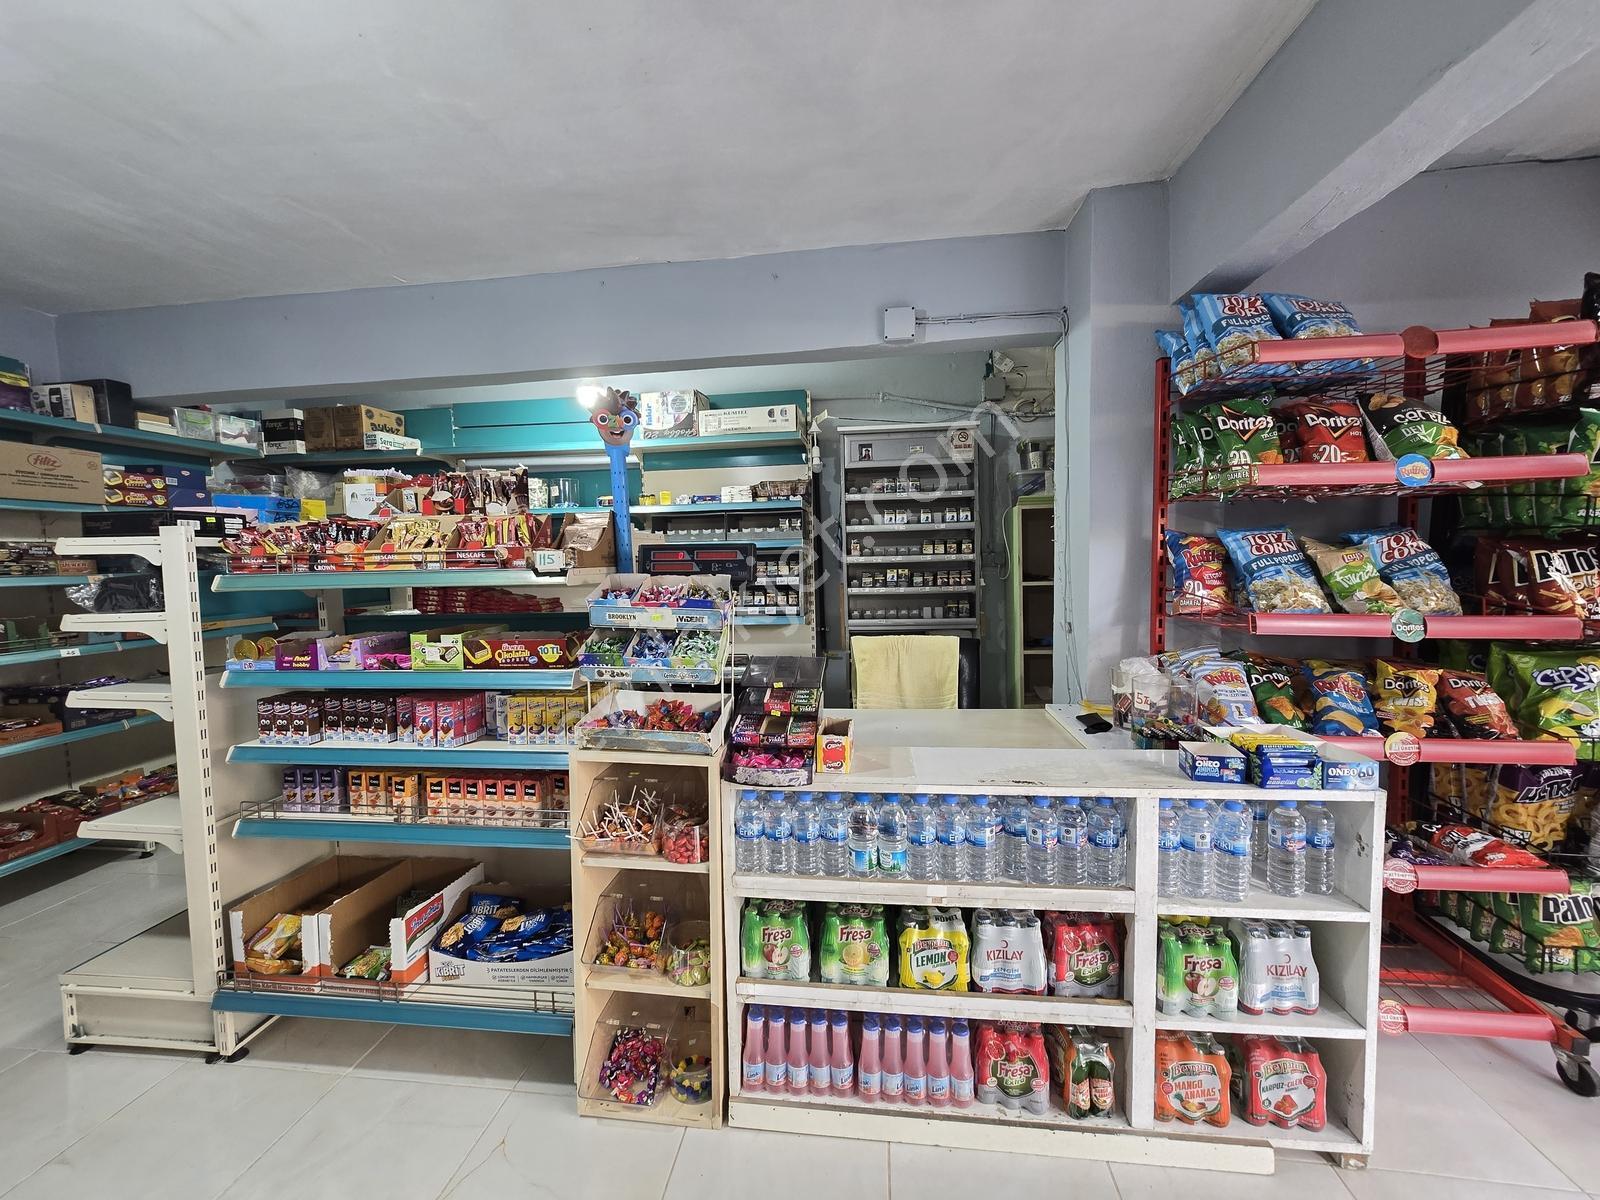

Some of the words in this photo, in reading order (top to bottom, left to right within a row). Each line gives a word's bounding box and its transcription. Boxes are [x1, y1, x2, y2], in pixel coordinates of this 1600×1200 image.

[1217, 416, 1273, 431] Doritos
[1243, 532, 1288, 546] TOPZ
[1250, 541, 1298, 556] CORN
[1252, 558, 1274, 570] FULL
[607, 613, 637, 621] BROOKLYN
[538, 646, 550, 656] 10
[551, 646, 563, 656] TL
[1384, 678, 1430, 693] Doritos
[1196, 760, 1220, 768] ONEO
[1328, 768, 1357, 776] ONEO
[916, 952, 947, 968] LEMON
[986, 950, 1024, 962] KIZILAY
[1184, 955, 1223, 971] Freşa
[1267, 964, 1308, 978] KIZILAY
[1174, 1080, 1203, 1091] MANGO
[1184, 1088, 1216, 1100] ANANAS
